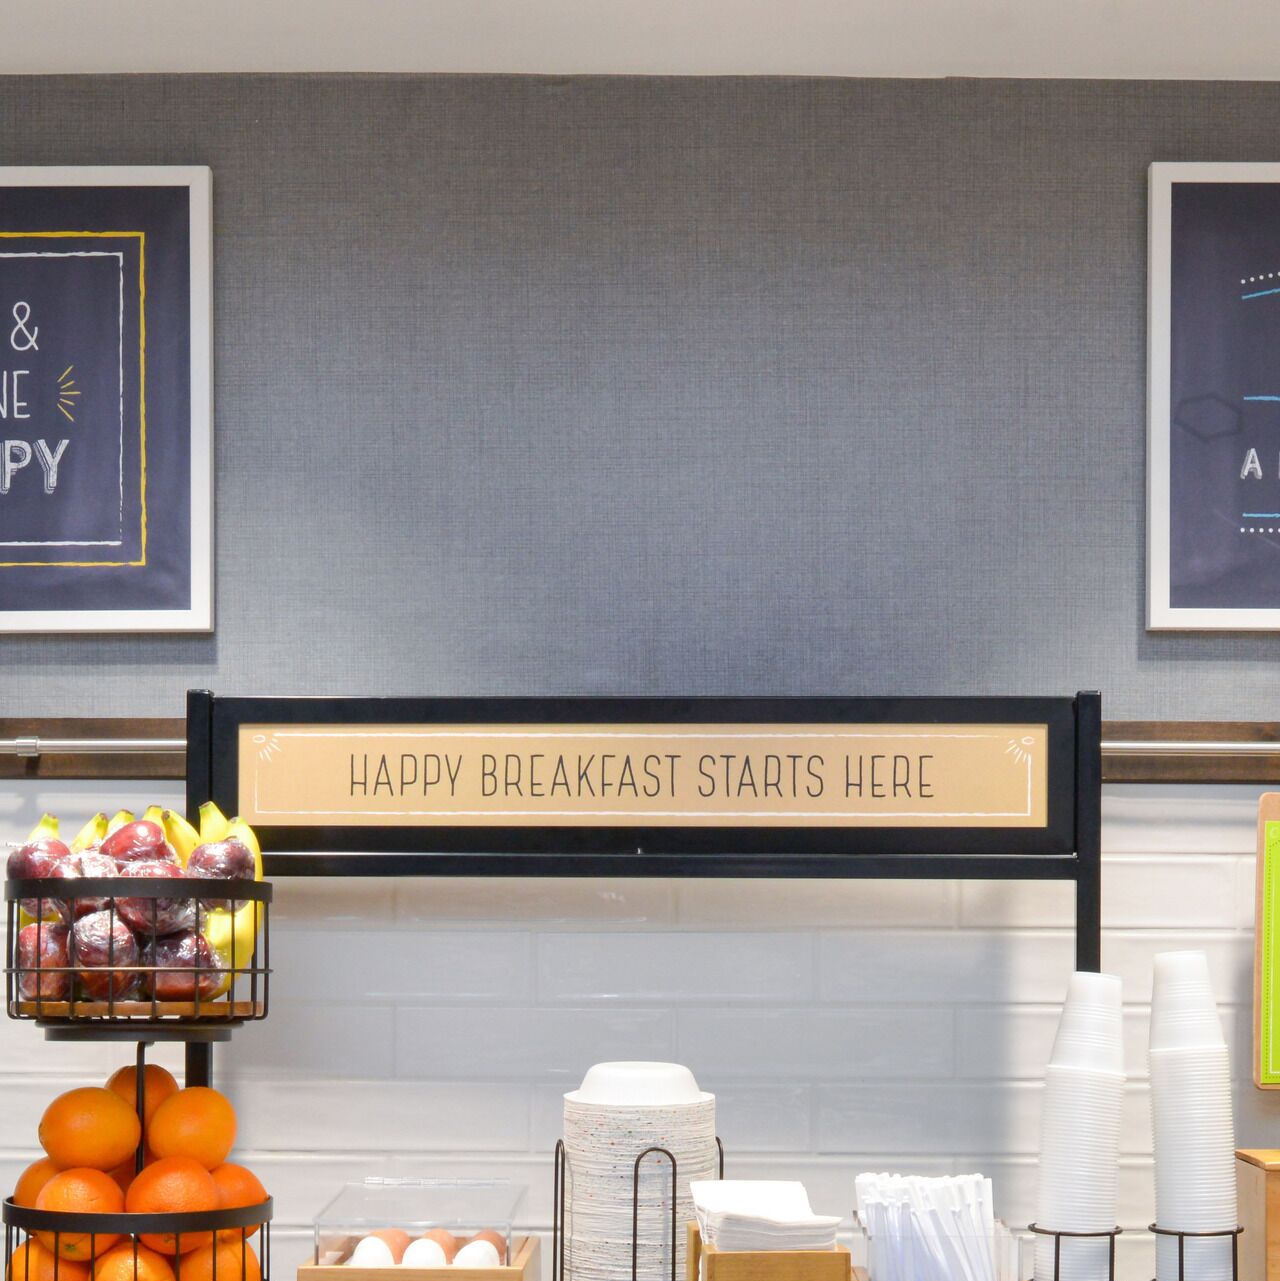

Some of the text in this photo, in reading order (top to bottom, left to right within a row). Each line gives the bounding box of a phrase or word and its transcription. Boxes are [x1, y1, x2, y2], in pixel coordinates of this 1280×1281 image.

[10, 300, 40, 352] &
[1239, 447, 1263, 480] A
[349, 753, 934, 799] HAPPY BREAKFAST STARTS HERE
